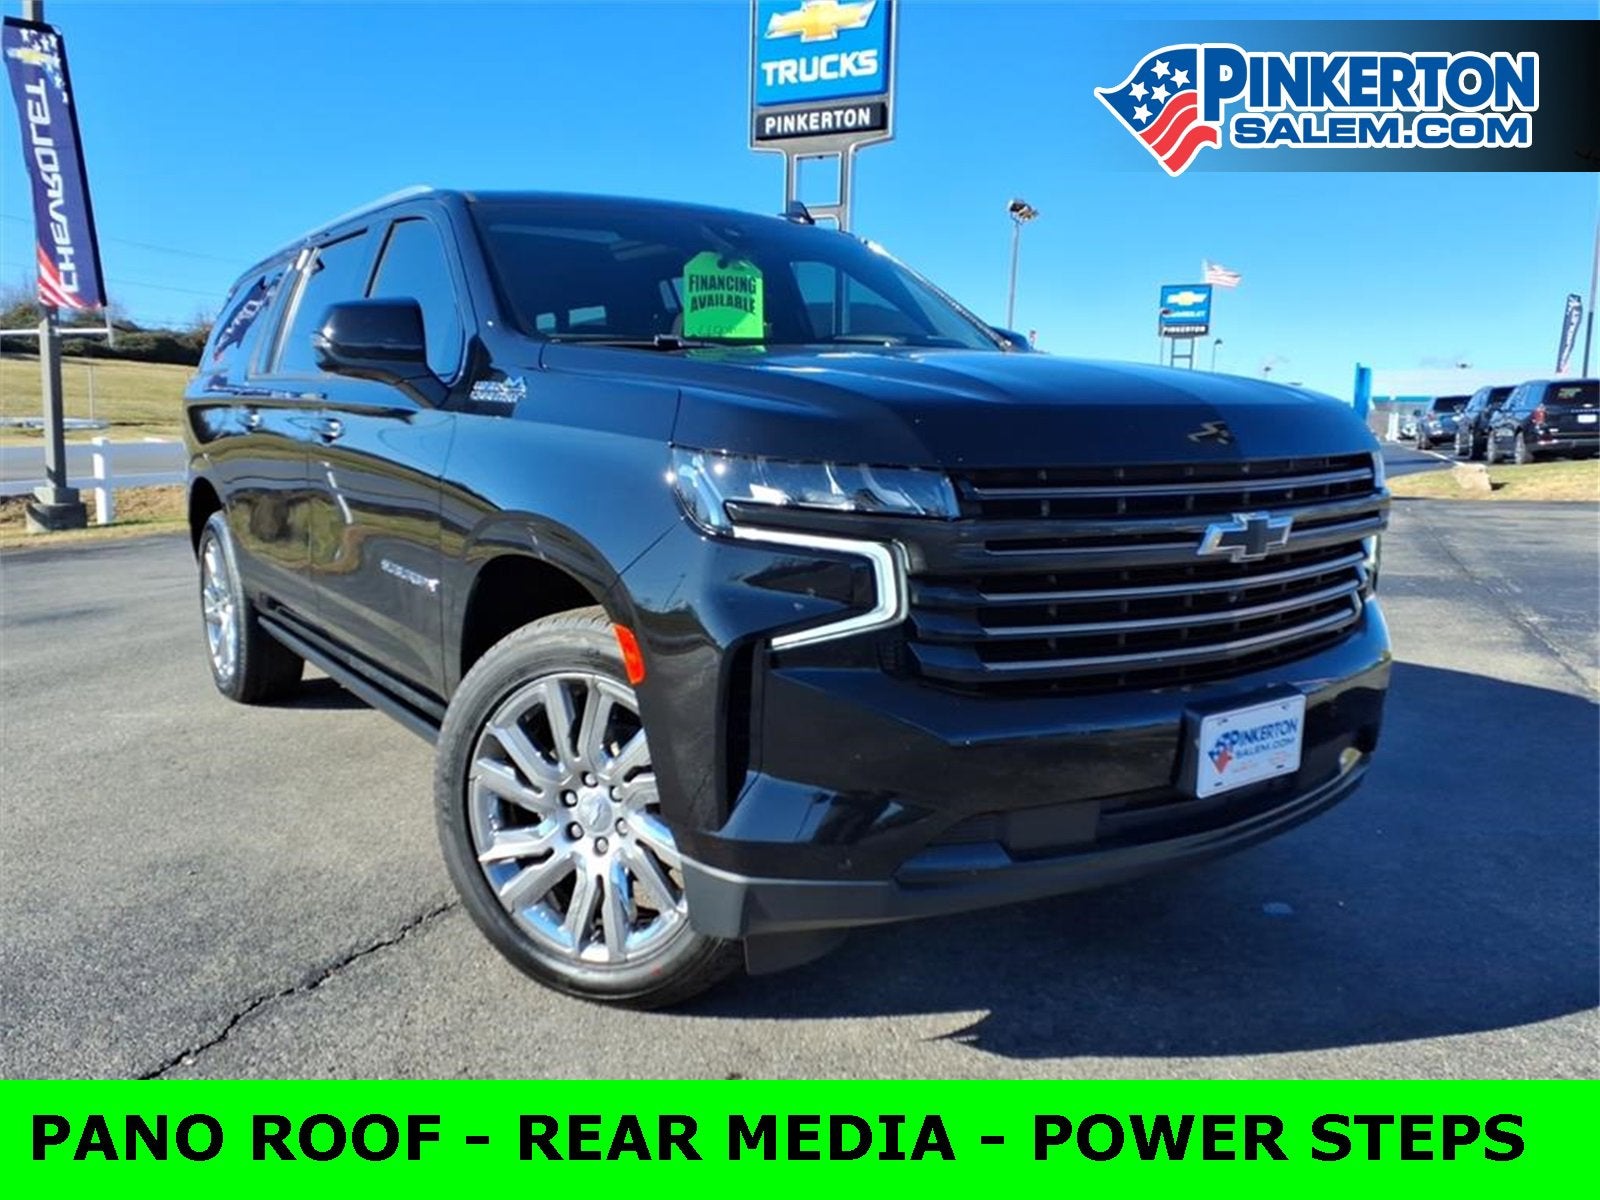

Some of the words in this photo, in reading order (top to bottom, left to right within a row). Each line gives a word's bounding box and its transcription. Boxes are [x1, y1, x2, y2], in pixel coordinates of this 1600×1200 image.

[761, 49, 878, 86] TRUCKS
[765, 107, 871, 135] PINKERTON
[689, 274, 757, 295] FINANCING
[690, 293, 757, 315] AVAILABLE
[1229, 718, 1299, 749] PINKERTON
